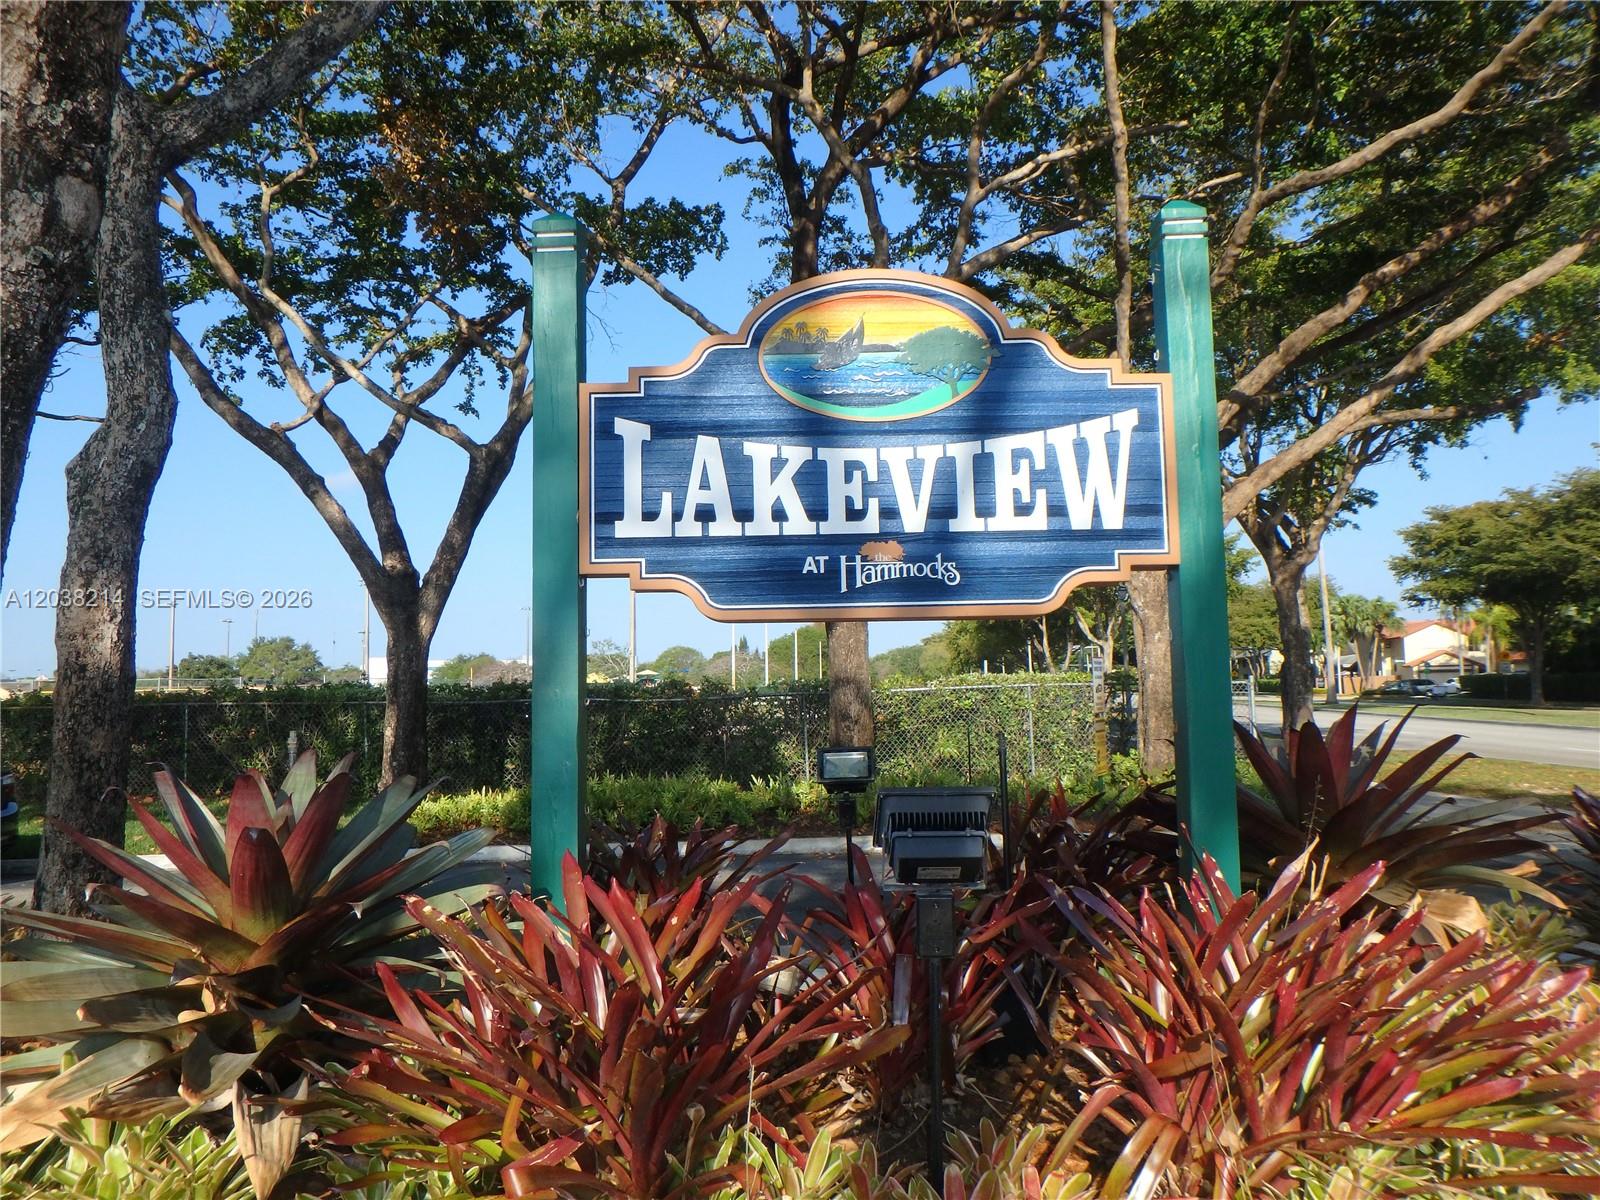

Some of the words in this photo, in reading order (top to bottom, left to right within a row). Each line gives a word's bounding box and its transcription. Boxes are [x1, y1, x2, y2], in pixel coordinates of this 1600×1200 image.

[613, 408, 1139, 538] LAKEVIEW
[802, 555, 830, 574] AT
[839, 552, 961, 594] Hammocks
[874, 552, 892, 562] the
